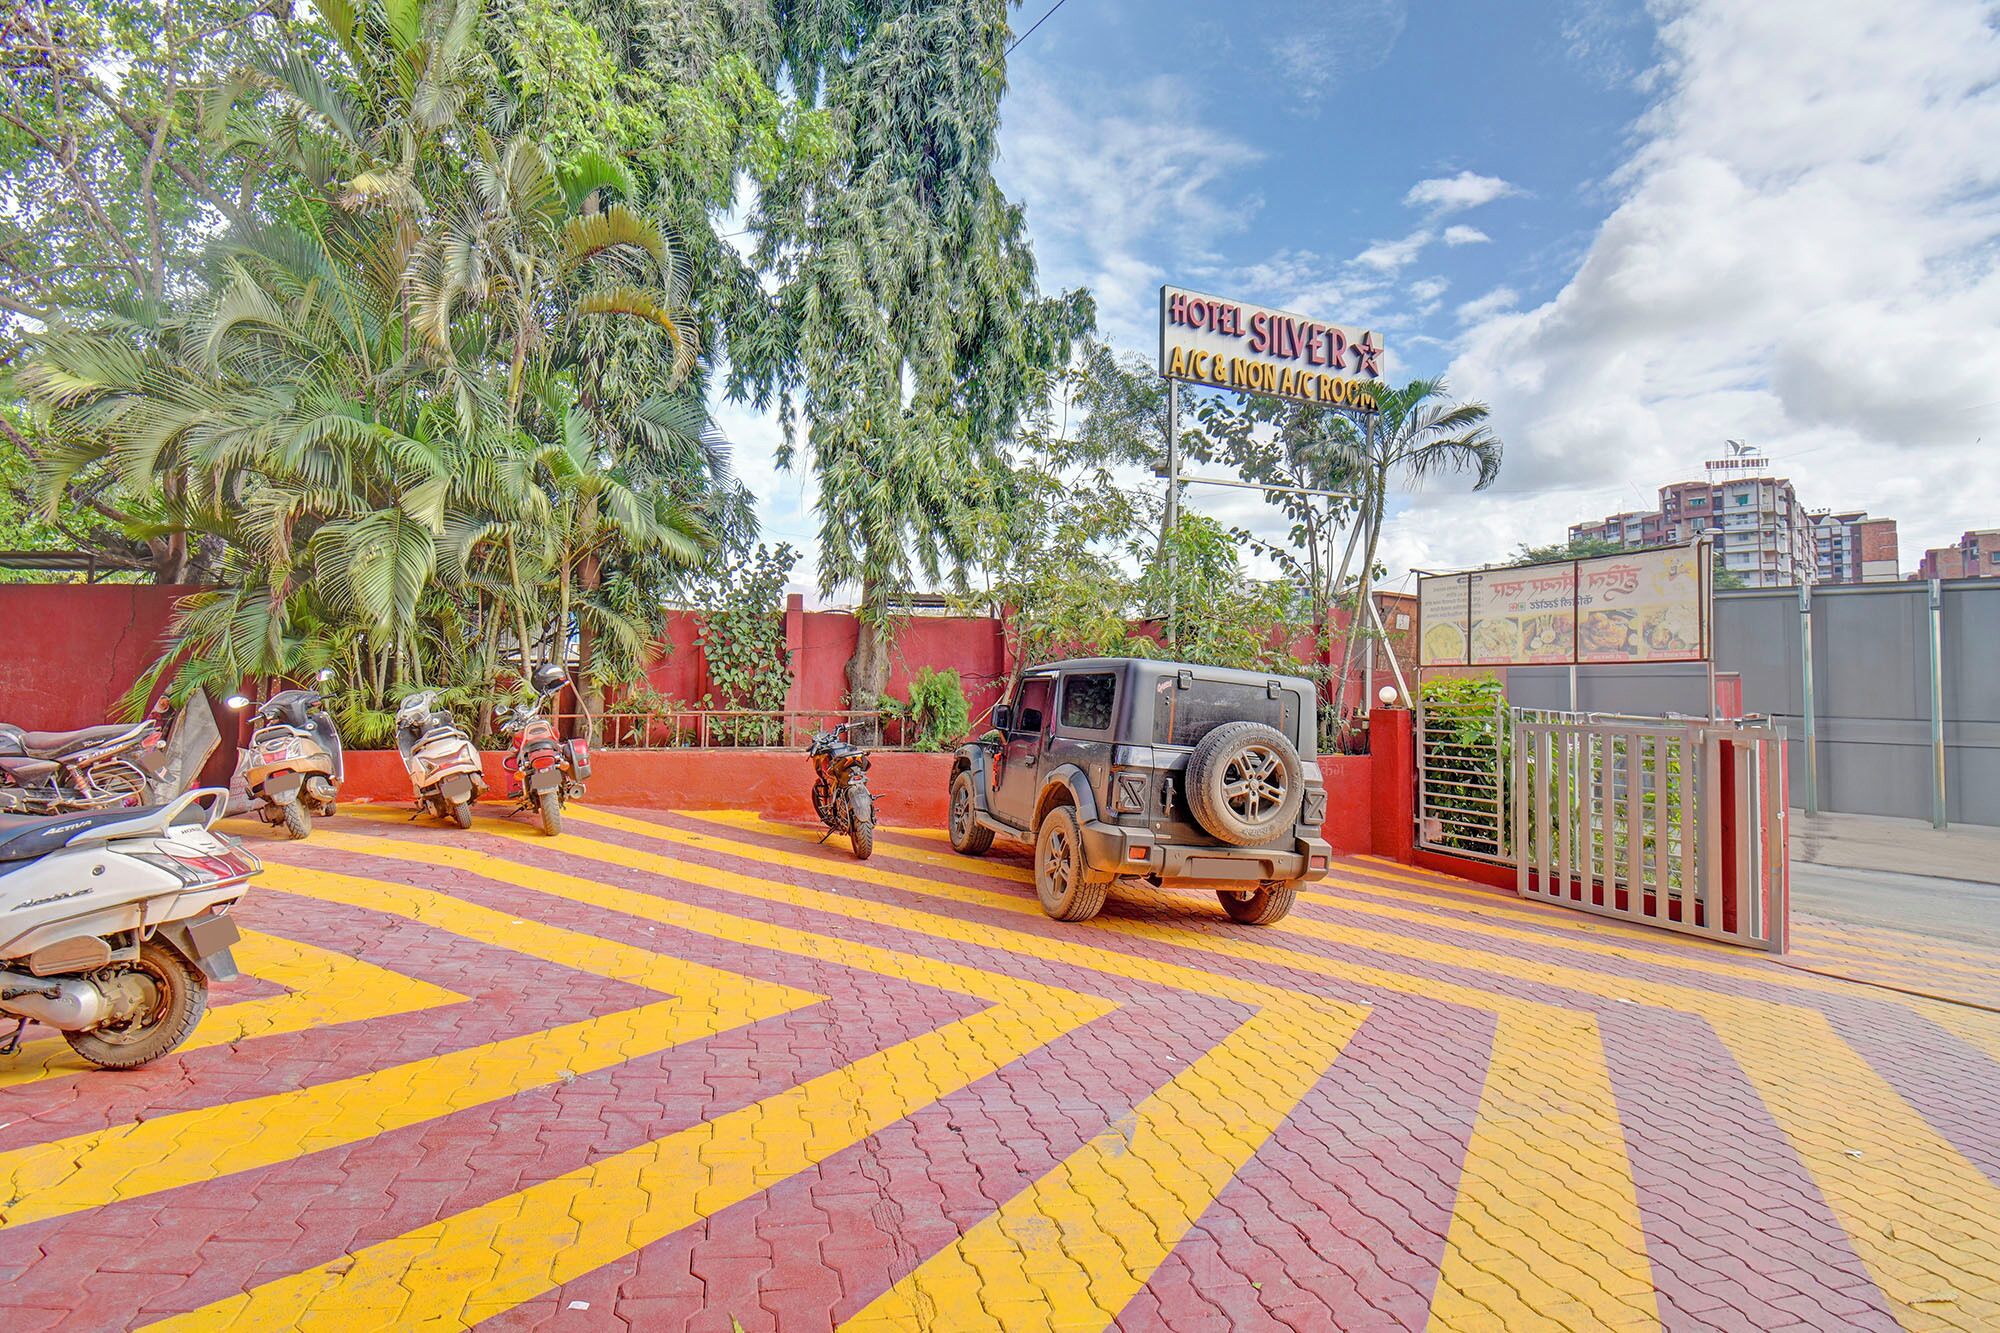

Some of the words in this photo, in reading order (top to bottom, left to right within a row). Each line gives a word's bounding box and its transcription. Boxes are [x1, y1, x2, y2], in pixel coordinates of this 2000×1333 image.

[1169, 293, 1246, 337] HOTEL
[1249, 311, 1347, 369] SILVER
[1170, 345, 1209, 379] A/C
[1213, 352, 1228, 382] &
[1232, 356, 1277, 392] NON
[1281, 366, 1315, 398] A/C
[41, 820, 93, 837] ACTIVA
